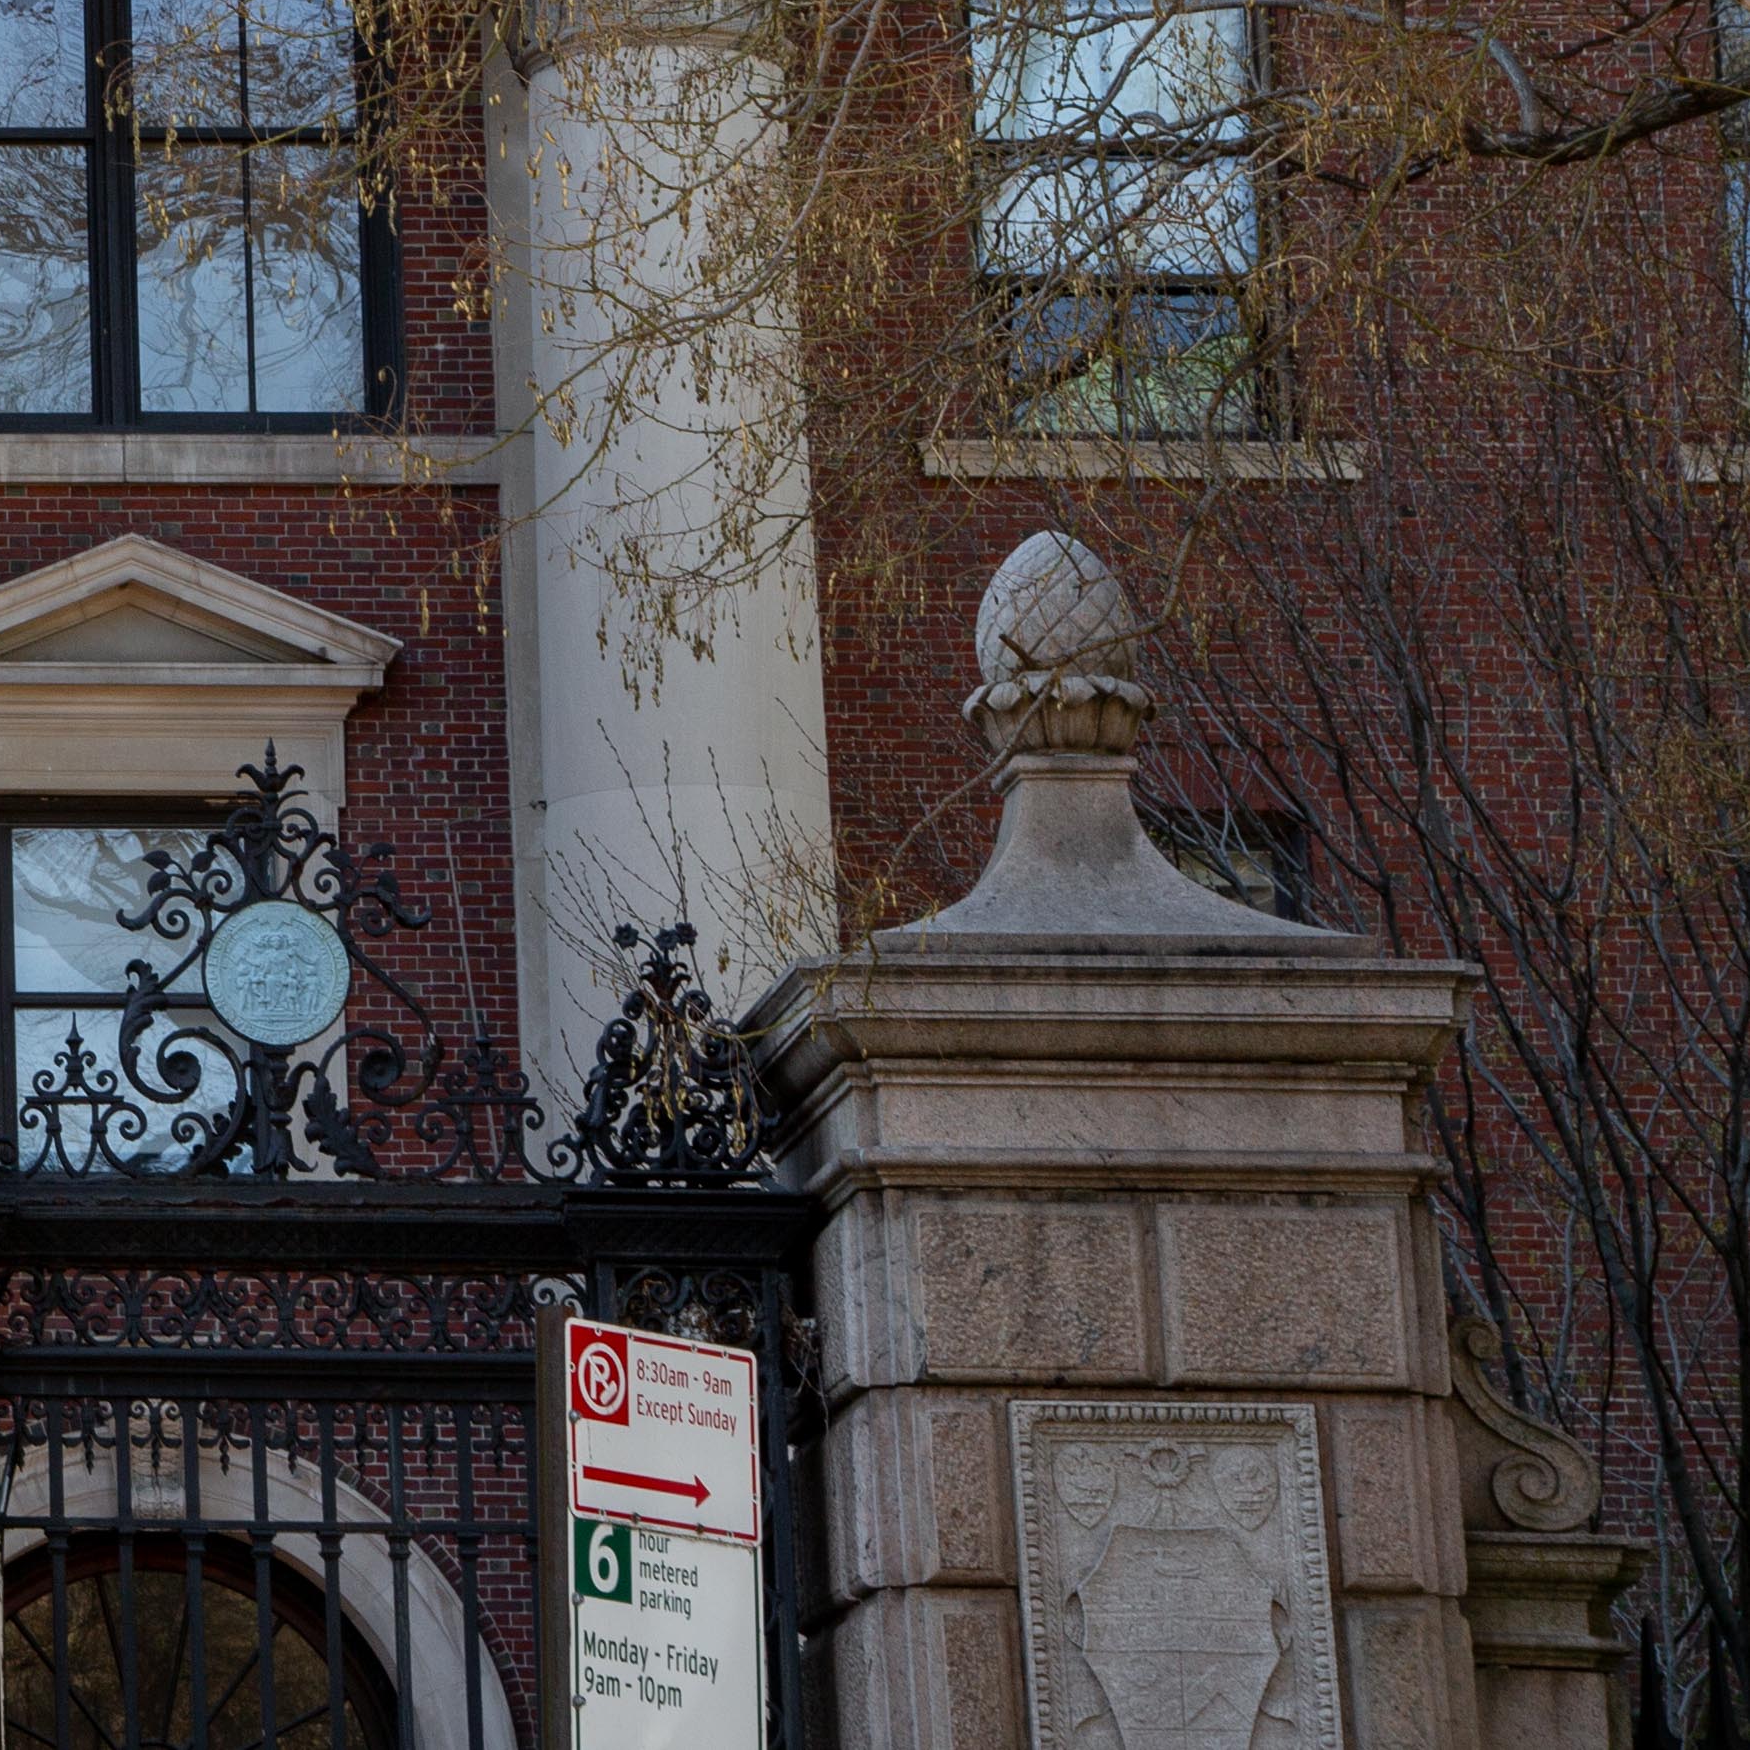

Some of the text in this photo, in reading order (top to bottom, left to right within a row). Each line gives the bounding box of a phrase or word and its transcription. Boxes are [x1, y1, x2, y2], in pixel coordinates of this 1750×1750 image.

[636, 1358, 689, 1389] 8:30am
[702, 1371, 733, 1397] 9am
[636, 1394, 738, 1437] Except Sunday
[589, 1524, 619, 1594] 6
[638, 1528, 671, 1554] hour
[639, 1559, 699, 1588] metered
[640, 1589, 692, 1621] parking
[583, 1629, 649, 1673] Monday
[666, 1643, 719, 1685] Friday
[584, 1665, 621, 1698] 9am
[637, 1674, 683, 1711] 10pm
